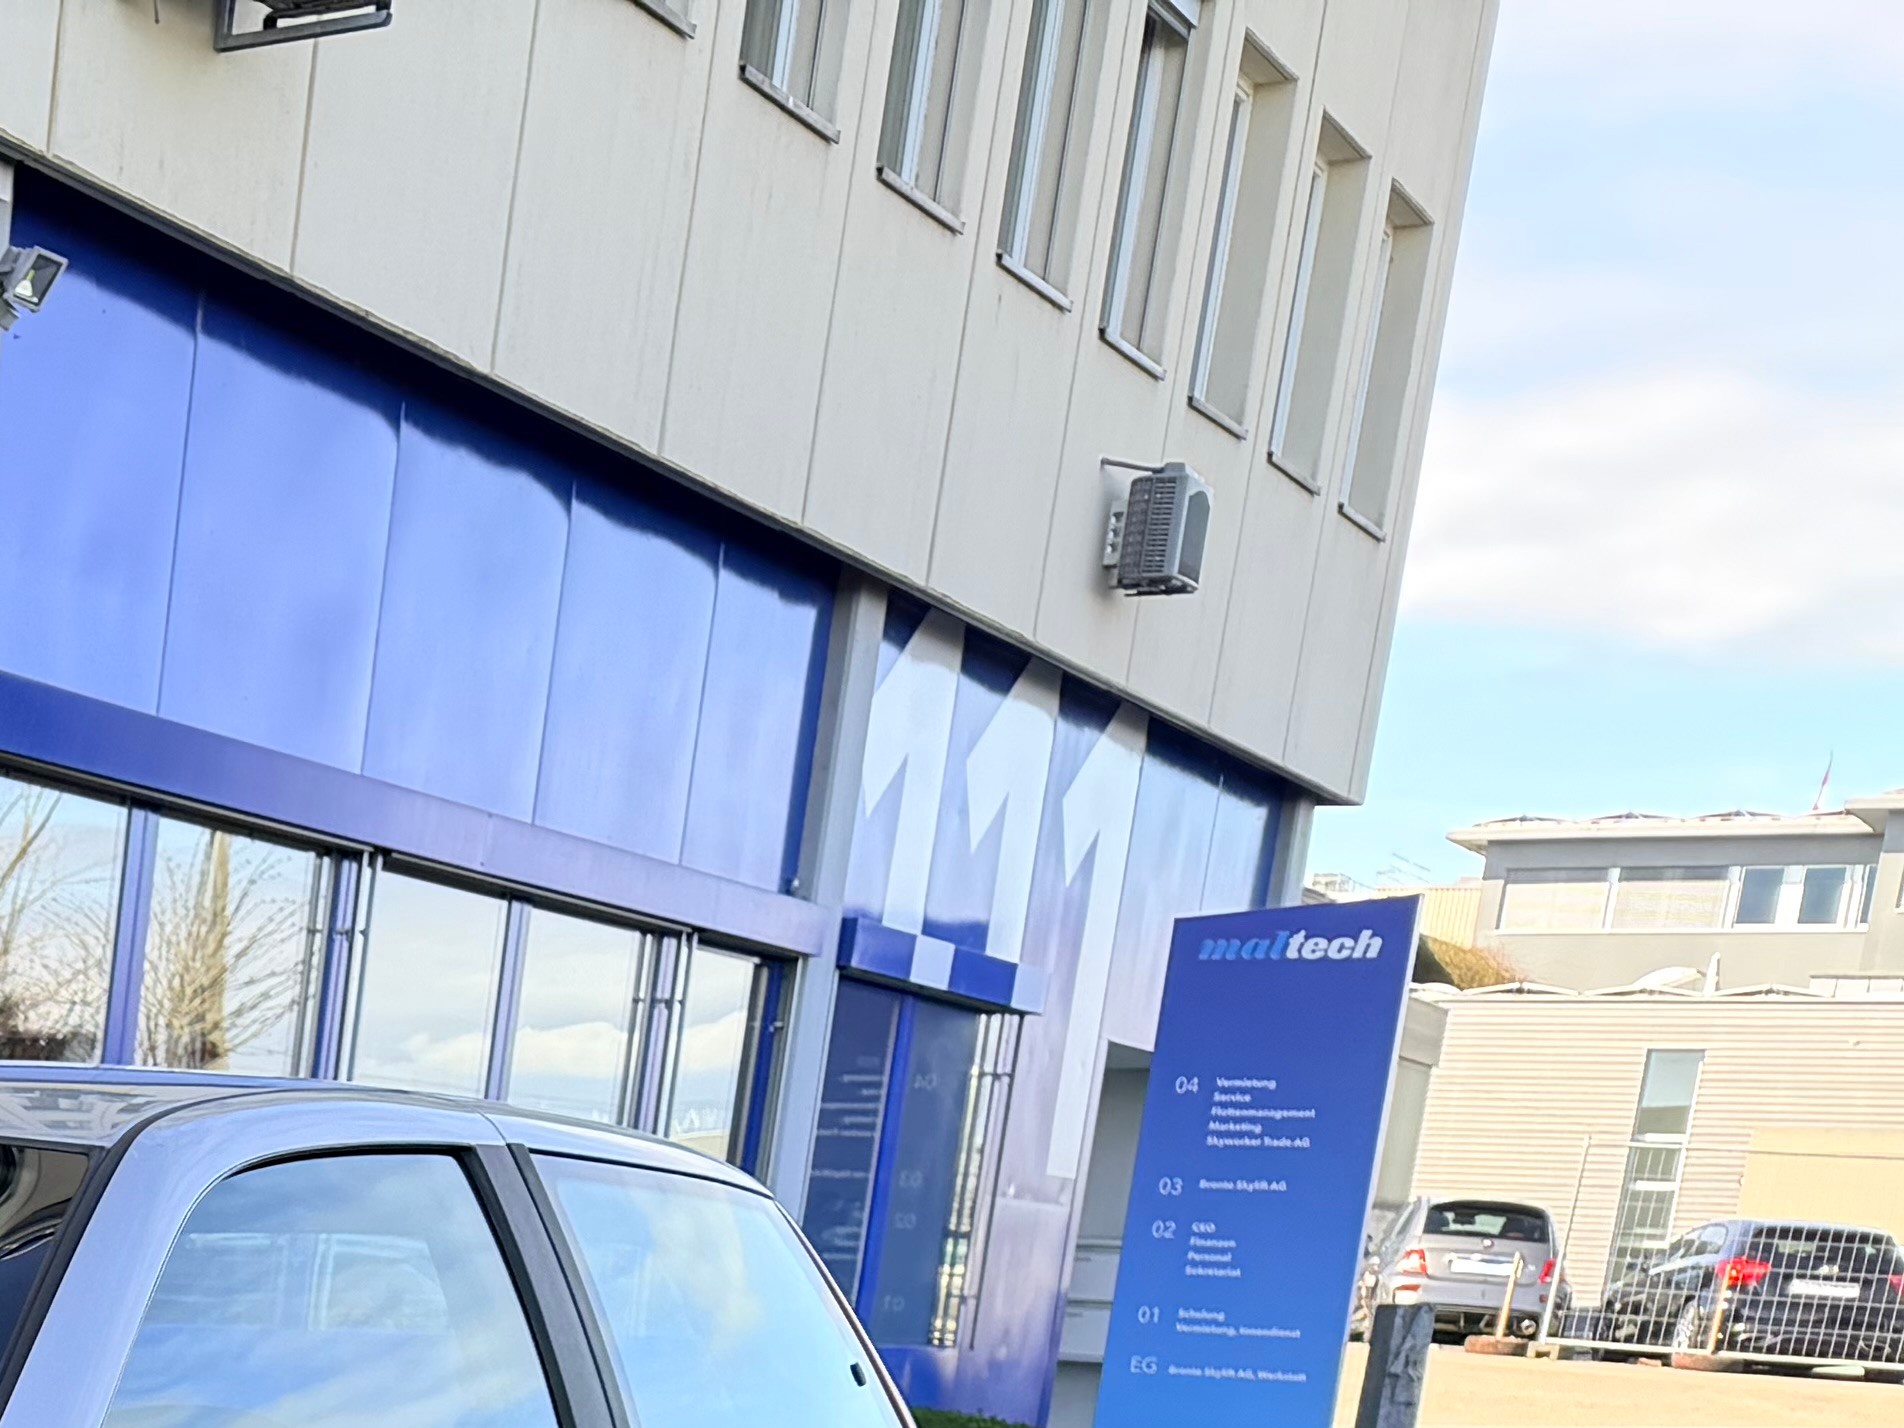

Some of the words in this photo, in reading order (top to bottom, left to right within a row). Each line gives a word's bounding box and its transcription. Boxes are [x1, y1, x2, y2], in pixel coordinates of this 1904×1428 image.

[1198, 928, 1384, 962] maltech
[1175, 1076, 1199, 1094] 04
[1216, 1077, 1277, 1090] Vermietung
[1213, 1091, 1252, 1103] Service
[1210, 1106, 1316, 1119] Flottenmanagement
[1208, 1121, 1262, 1134] Marketing
[1158, 1177, 1183, 1196] 03
[1152, 1220, 1176, 1238] 02
[1190, 1236, 1236, 1248] Finanzen
[1187, 1251, 1232, 1262] Personal
[1185, 1265, 1241, 1278] Sekretariat
[1138, 1305, 1160, 1324] 01
[1178, 1307, 1225, 1322] Schulung
[1130, 1355, 1158, 1374] EG
